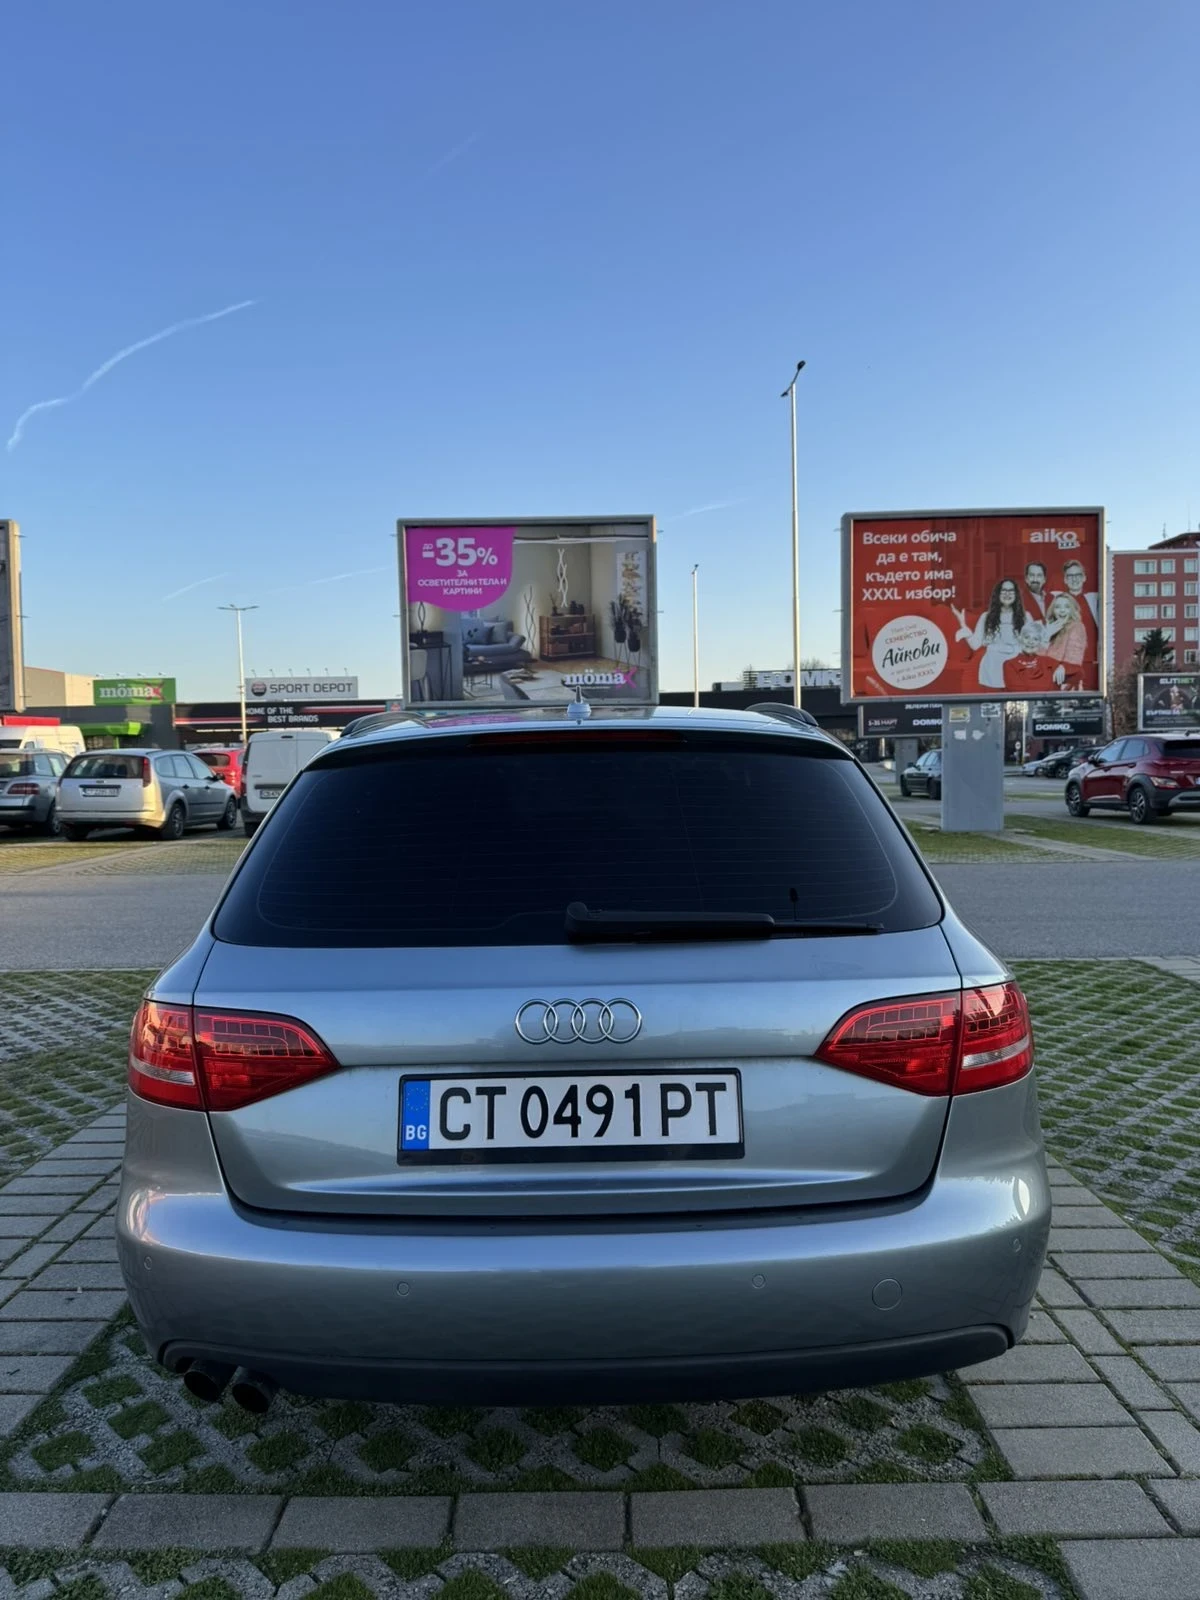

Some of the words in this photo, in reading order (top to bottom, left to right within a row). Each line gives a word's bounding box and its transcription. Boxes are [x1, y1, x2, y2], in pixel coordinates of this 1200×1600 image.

[862, 532, 907, 544] Всеки
[910, 530, 957, 544] обича
[1029, 528, 1077, 543] aiko
[422, 537, 498, 566] -35%
[876, 552, 896, 566] да
[899, 552, 908, 562] е
[911, 551, 942, 563] там,
[456, 569, 468, 577] ЗА
[865, 570, 921, 584] където
[924, 569, 953, 580] има
[417, 579, 477, 587] ОСВЕТИТЕЛНИ
[478, 578, 499, 586] ТЕЛА
[443, 587, 483, 595] КАРТИНИ
[862, 587, 902, 601] XXXL
[904, 585, 957, 602] избор!
[882, 637, 940, 669] Айкови
[269, 683, 310, 694] SPORT
[313, 682, 353, 693] DEPOT
[280, 706, 294, 714] THE
[267, 715, 287, 723] BEST
[288, 714, 319, 723] BRANDS
[439, 1086, 507, 1141] CT
[520, 1083, 641, 1139] 0491
[659, 1082, 727, 1137] PT
[405, 1125, 427, 1141] BG
